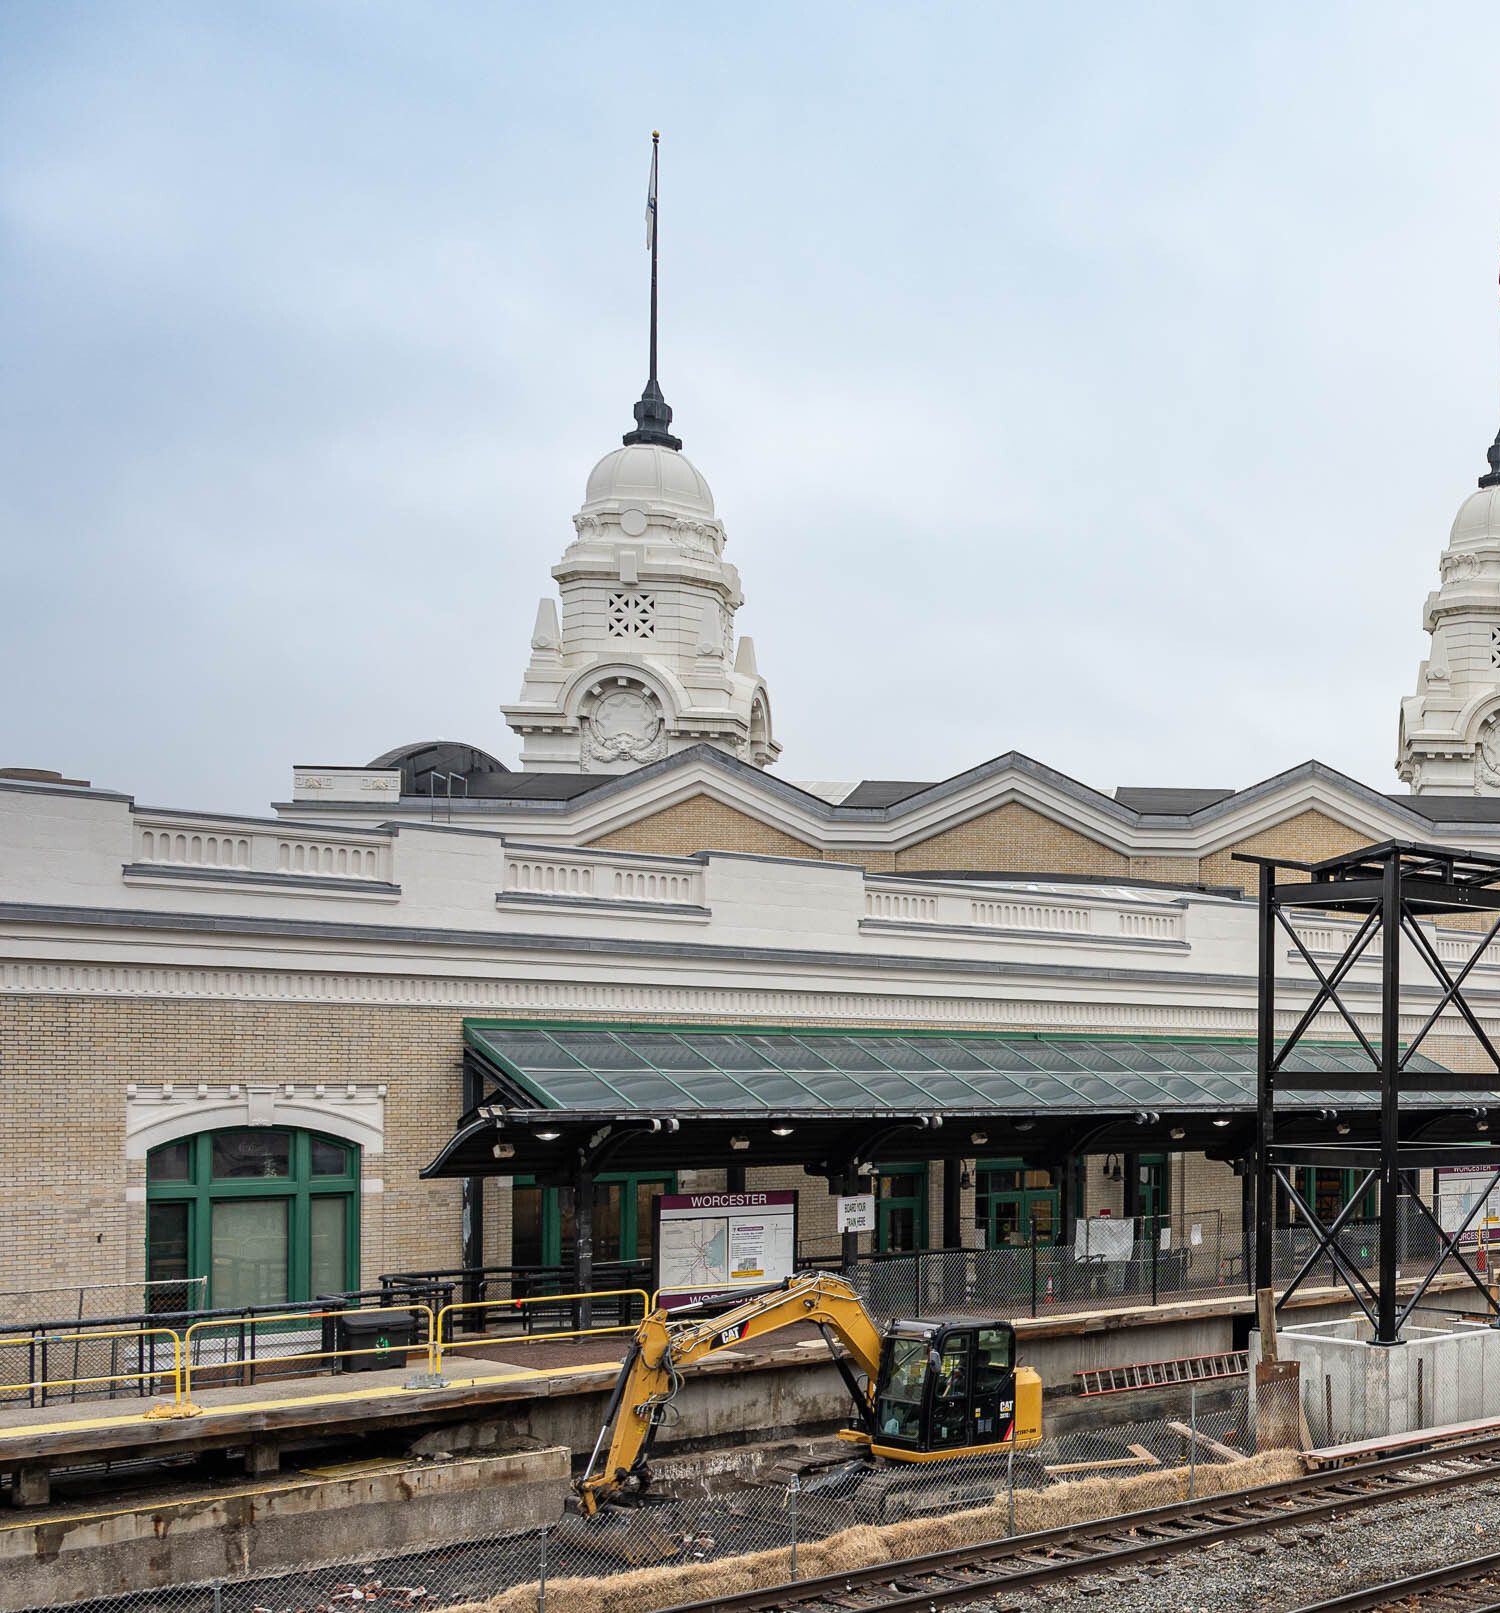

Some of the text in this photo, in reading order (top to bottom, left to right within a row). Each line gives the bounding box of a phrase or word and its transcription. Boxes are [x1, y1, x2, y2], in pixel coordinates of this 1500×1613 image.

[691, 1193, 767, 1207] WORCESTER
[844, 1201, 866, 1213] BOARD YOUR
[846, 1216, 866, 1227] TRAIN HERE
[721, 1326, 740, 1344] CAT
[1000, 1400, 1014, 1412] CAT
